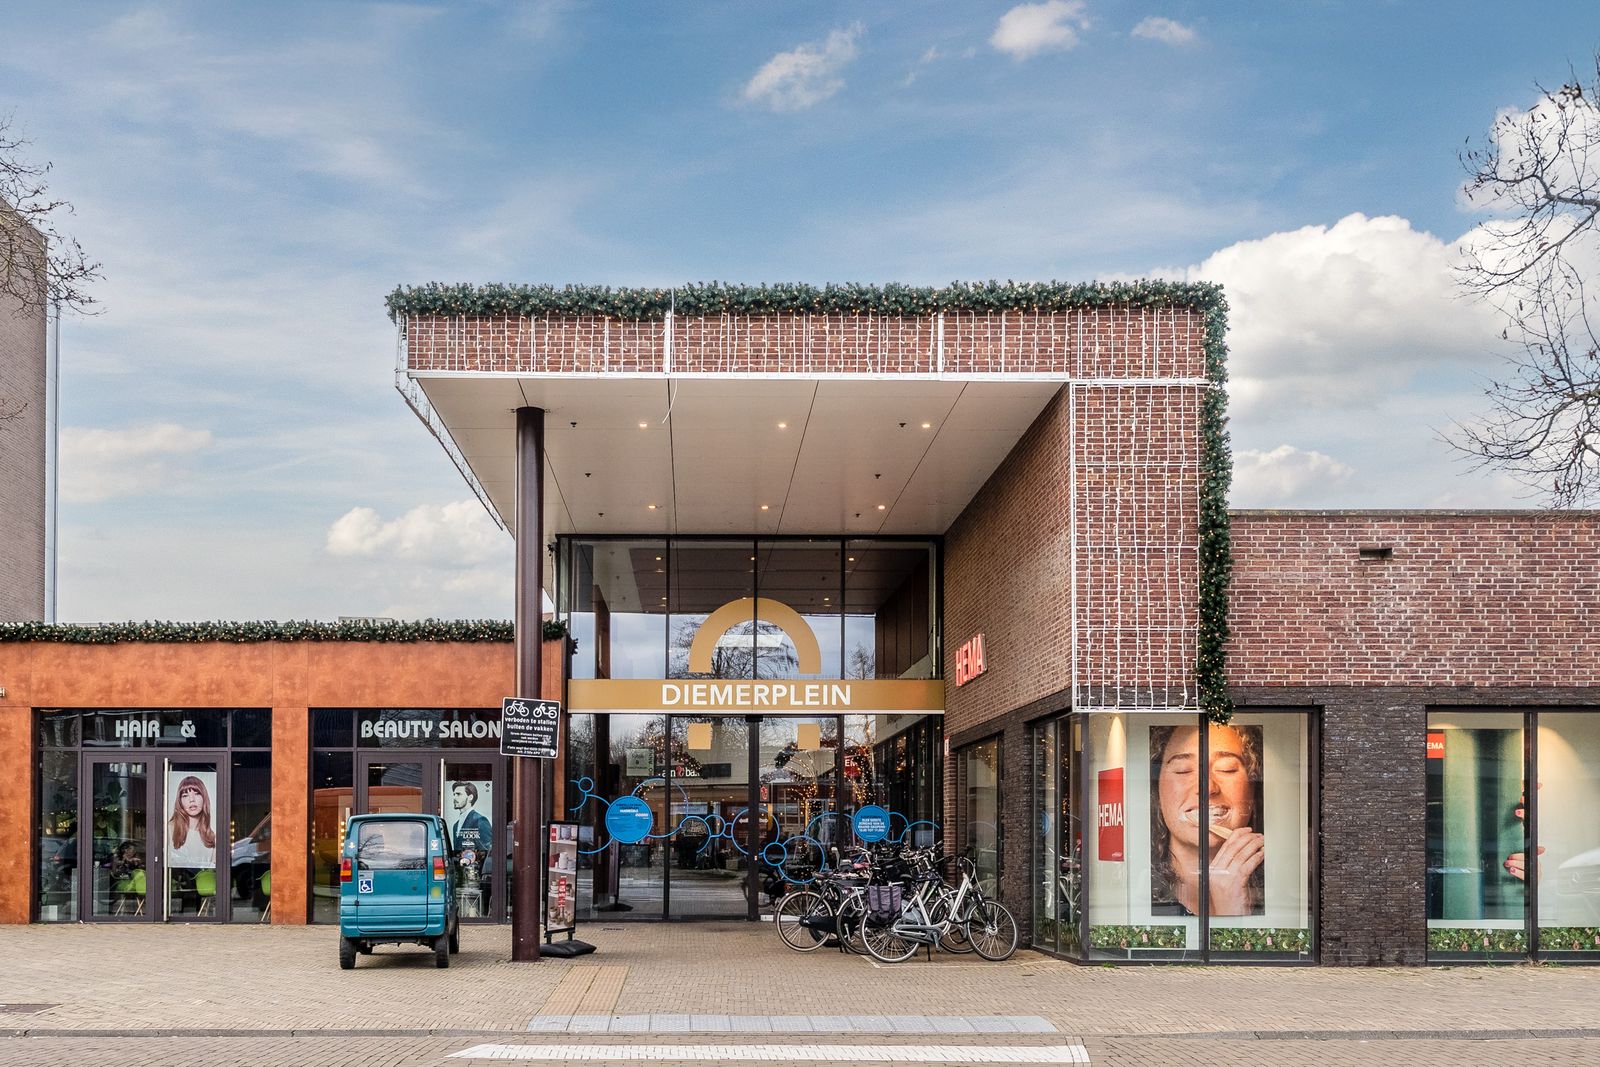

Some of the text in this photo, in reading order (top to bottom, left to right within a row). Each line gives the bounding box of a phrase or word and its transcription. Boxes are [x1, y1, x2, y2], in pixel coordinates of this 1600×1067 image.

[955, 633, 983, 688] HEMA
[661, 684, 851, 706] DIEMERPLEIN
[115, 720, 197, 738] HAIR &
[361, 720, 501, 738] BEAUTY SALON
[1427, 742, 1444, 750] EMA
[1098, 803, 1124, 828] HEMA
